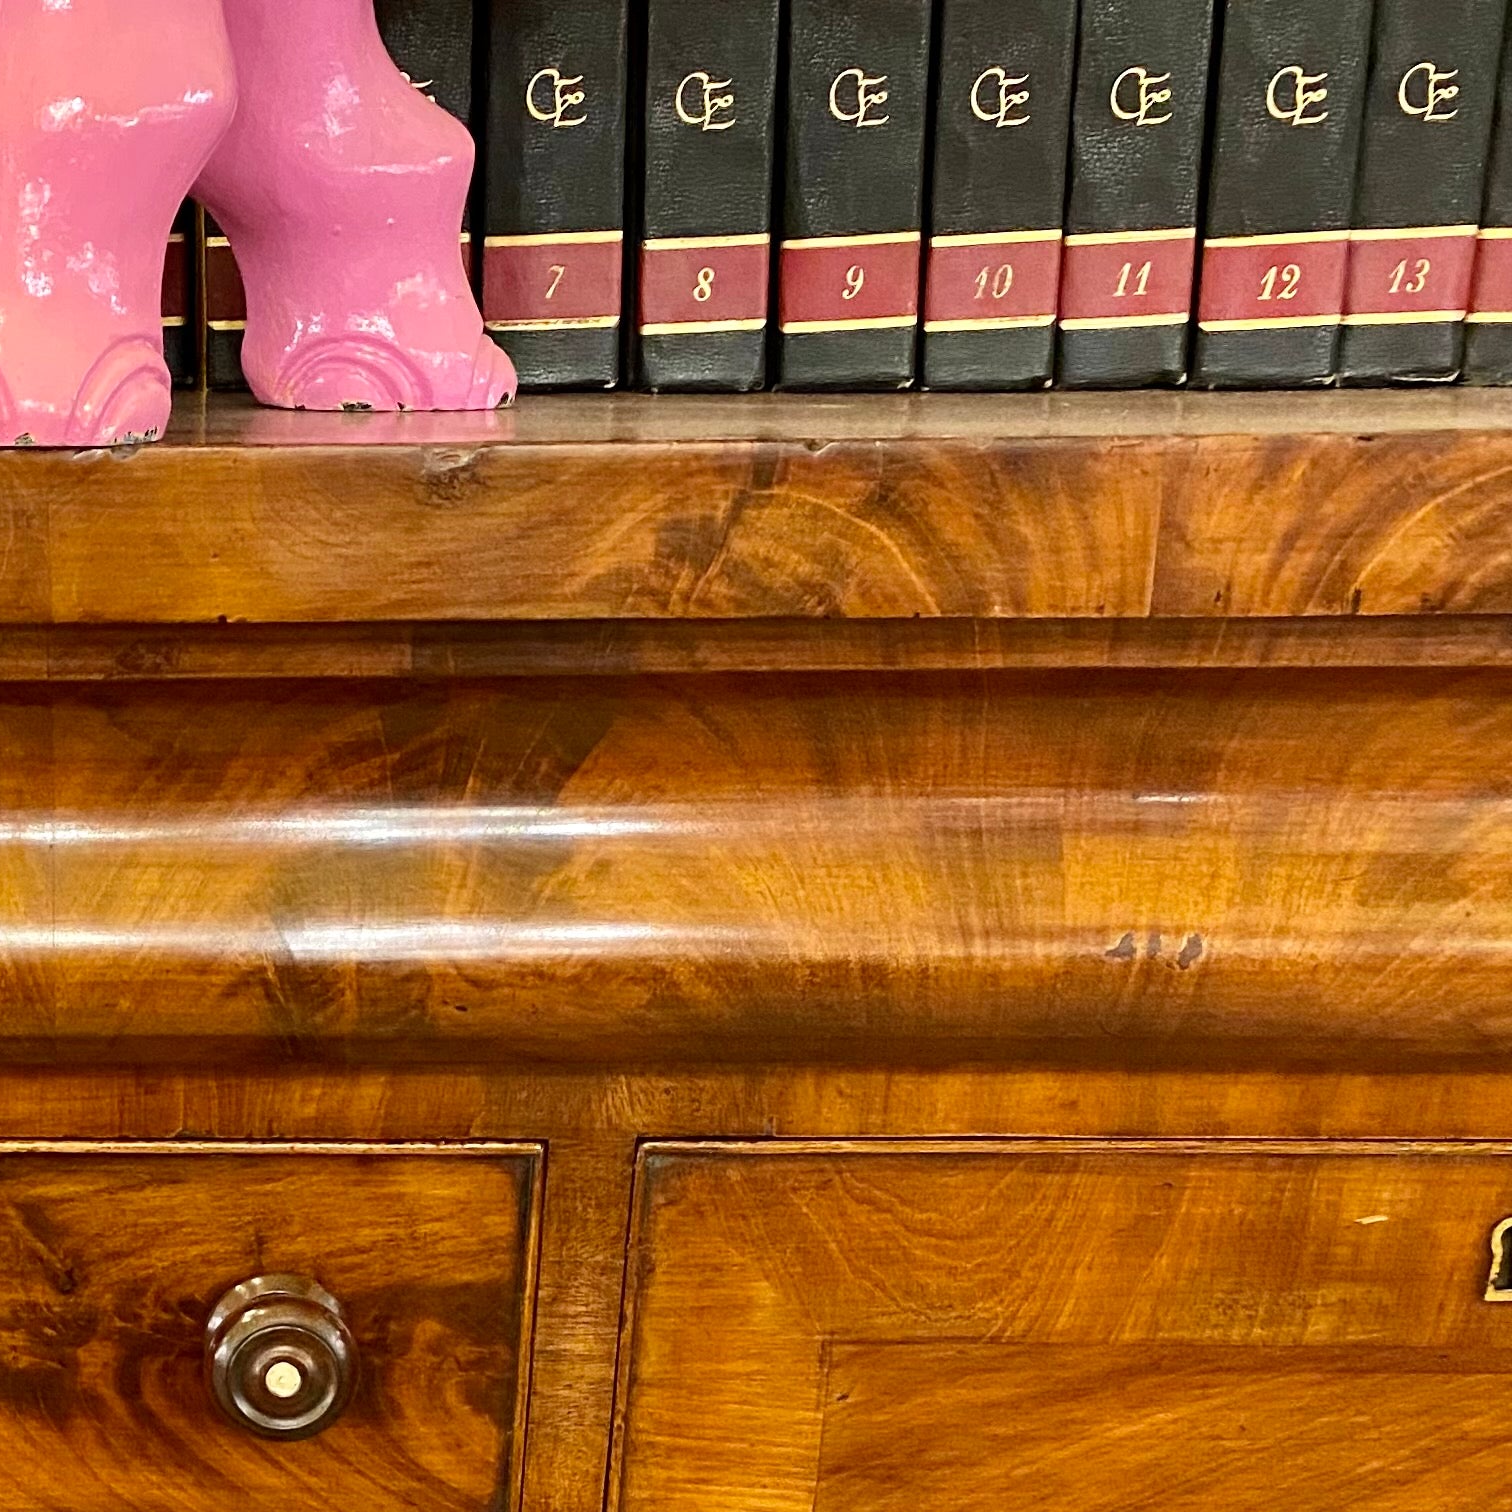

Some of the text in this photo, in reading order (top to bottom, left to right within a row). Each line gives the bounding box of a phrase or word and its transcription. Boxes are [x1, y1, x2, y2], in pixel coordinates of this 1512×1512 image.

[545, 265, 565, 299] 7
[692, 267, 715, 302] 8
[842, 265, 864, 300] 9
[974, 264, 1014, 299] 10
[1112, 261, 1152, 297] 11
[1256, 264, 1301, 301] 12
[1388, 258, 1431, 293] 13
